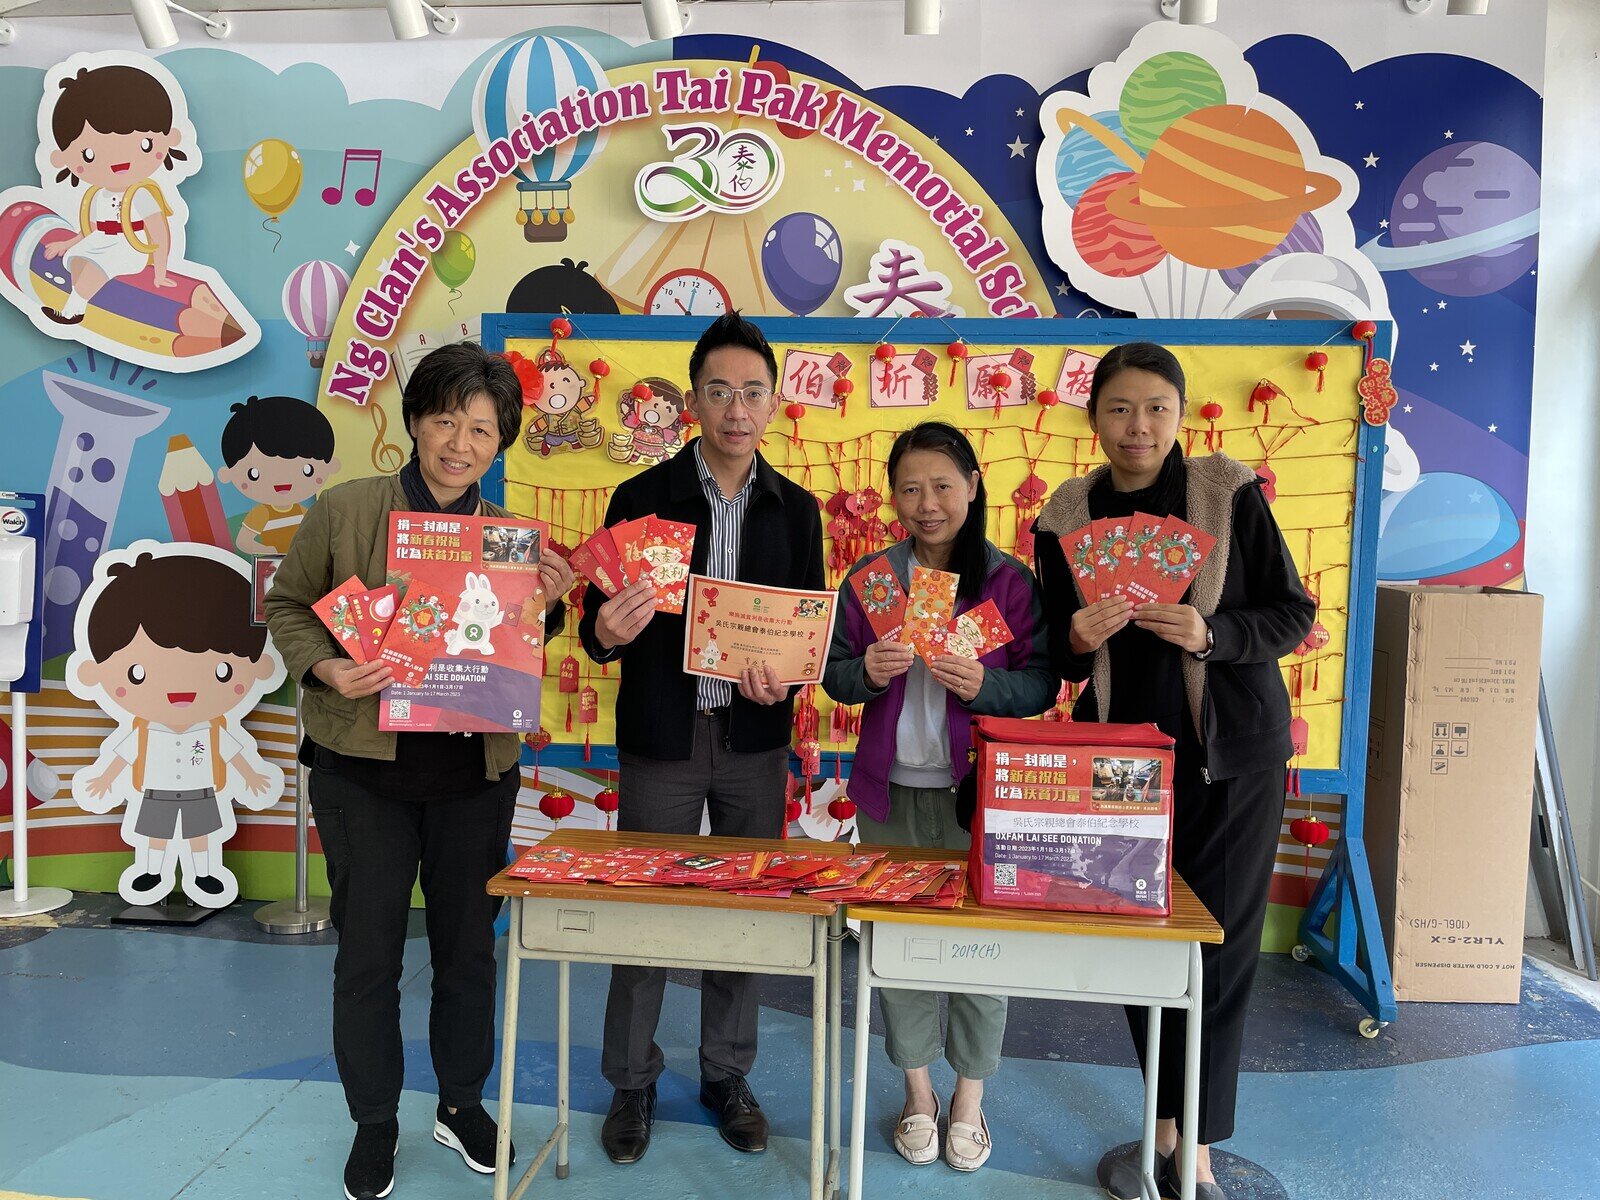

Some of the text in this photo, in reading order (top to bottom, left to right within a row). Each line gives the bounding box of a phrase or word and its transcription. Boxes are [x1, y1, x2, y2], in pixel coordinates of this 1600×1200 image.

[656, 70, 728, 113] Tai
[737, 71, 824, 128] Pak
[427, 81, 648, 226] Association
[825, 97, 1005, 271] Memorial
[356, 218, 441, 338] Clan's
[678, 280, 686, 288] 11
[692, 281, 700, 289] 12
[664, 288, 673, 296] 10
[461, 323, 468, 336] B
[419, 333, 427, 345] A
[329, 341, 388, 404] Ng
[789, 359, 824, 400] 伯
[2, 518, 24, 526] Walch
[396, 532, 461, 548] 將新春祝福
[395, 546, 473, 563] 化為扶貧力量
[434, 673, 449, 681] SEE
[450, 673, 486, 683] DONATION
[995, 768, 1067, 785] 將新春祝福
[994, 784, 1081, 803] 化為扶貧力量
[1013, 816, 1140, 829] 吳氏宗親總會泰伯紀念學校
[995, 832, 1102, 845] OXFAM LAI SEE DONATION
[1012, 853, 1031, 861] January
[1409, 918, 1470, 929] (106L-G/HS)
[1431, 935, 1505, 945] YLR2-5-X
[951, 943, 1001, 960] 2019(H)
